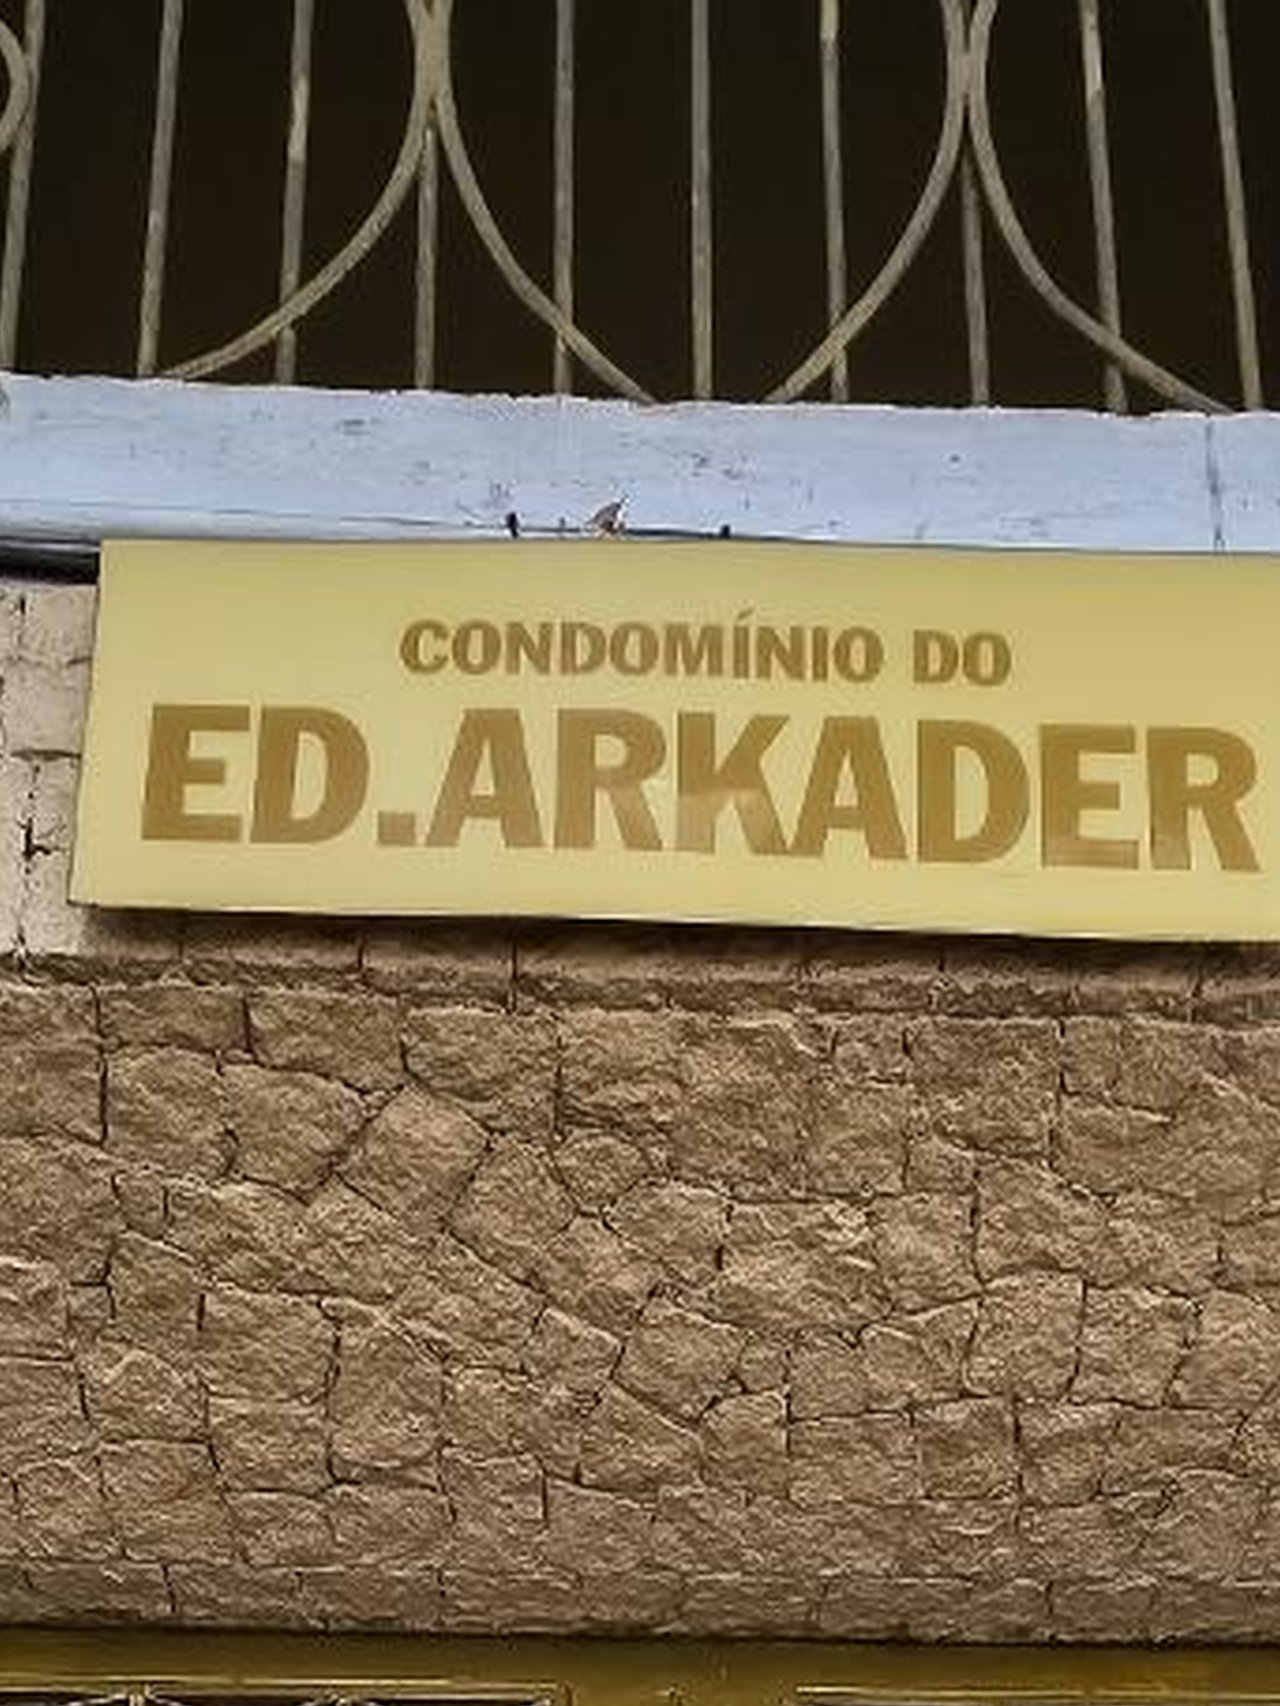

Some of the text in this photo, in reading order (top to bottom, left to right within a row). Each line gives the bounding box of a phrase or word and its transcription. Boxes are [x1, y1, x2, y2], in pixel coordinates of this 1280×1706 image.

[399, 607, 1013, 688] CONDOMÍNIO DO
[140, 702, 1263, 873] ED.ARKADER
